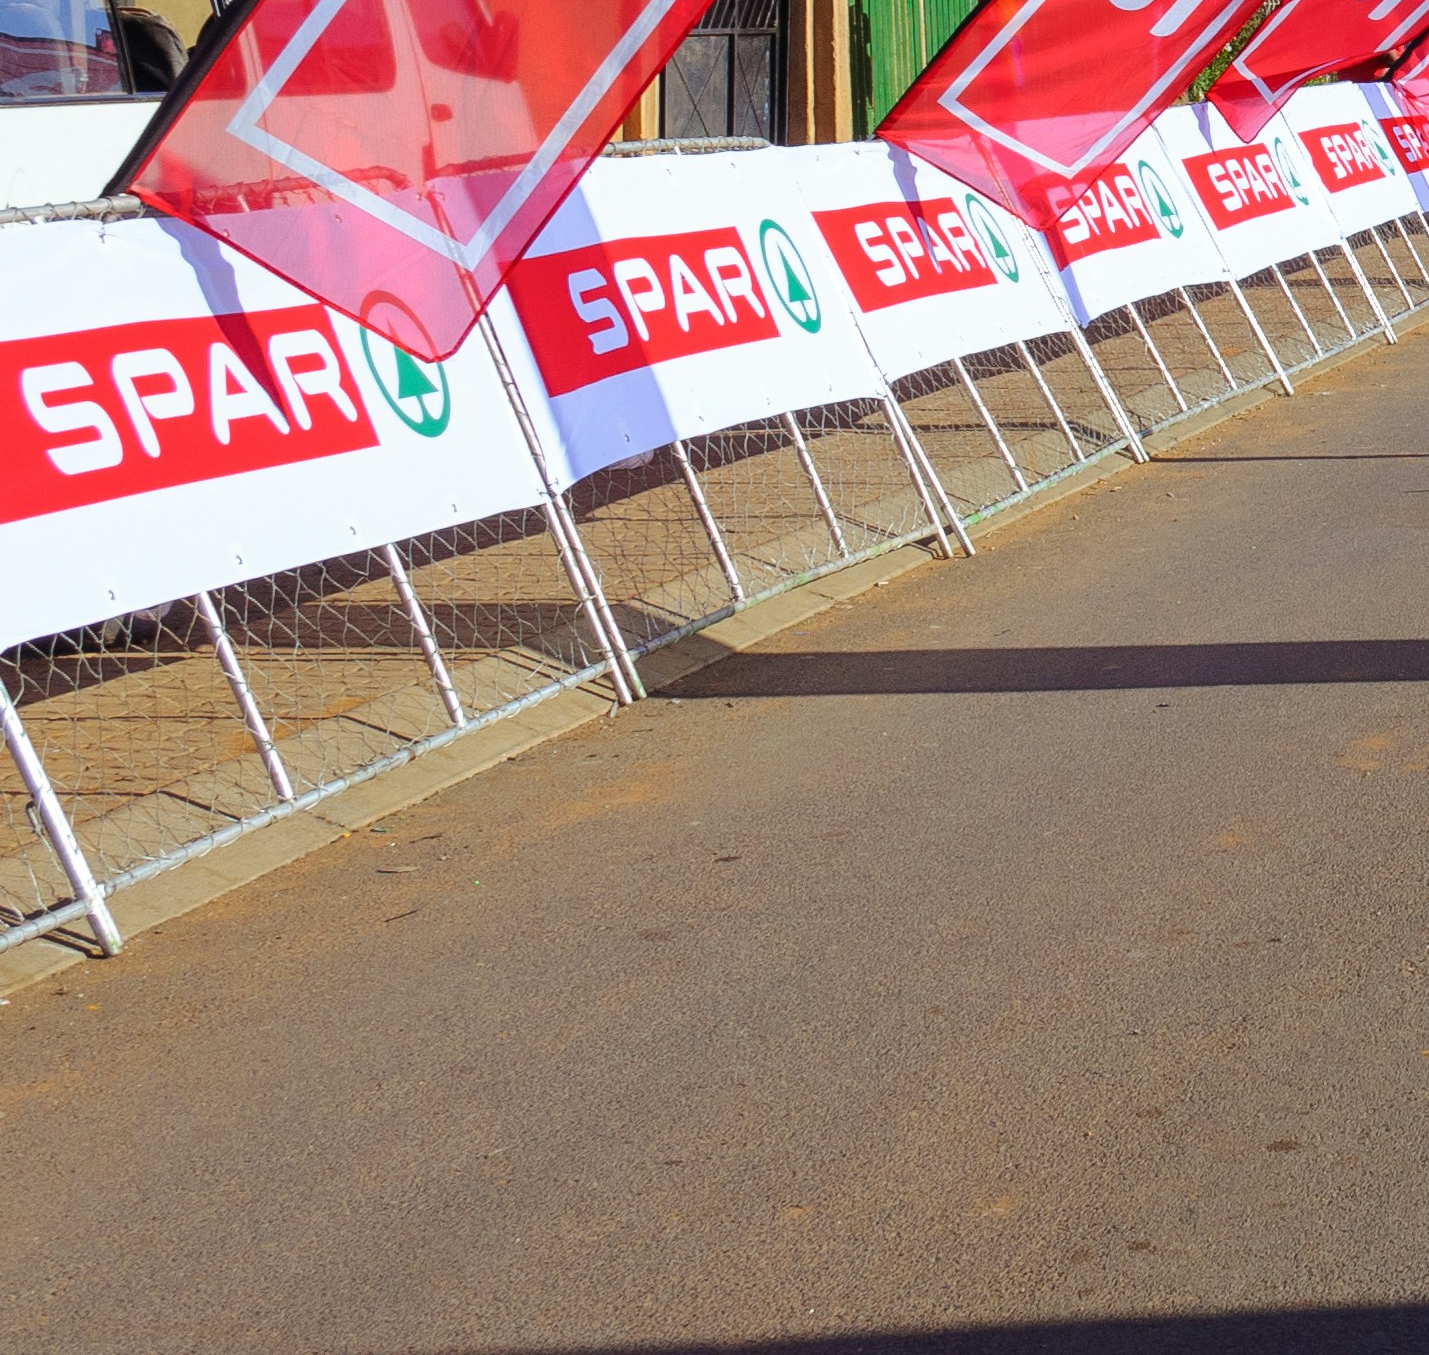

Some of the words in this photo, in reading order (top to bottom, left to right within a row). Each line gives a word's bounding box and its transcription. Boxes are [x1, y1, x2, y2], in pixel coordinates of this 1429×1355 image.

[1207, 153, 1289, 212] SPAR
[1321, 129, 1378, 180] SPAR
[1048, 174, 1156, 245] SPAR
[855, 211, 987, 288] SPAR
[568, 247, 766, 356] SPAR
[19, 329, 359, 476] SPAR
